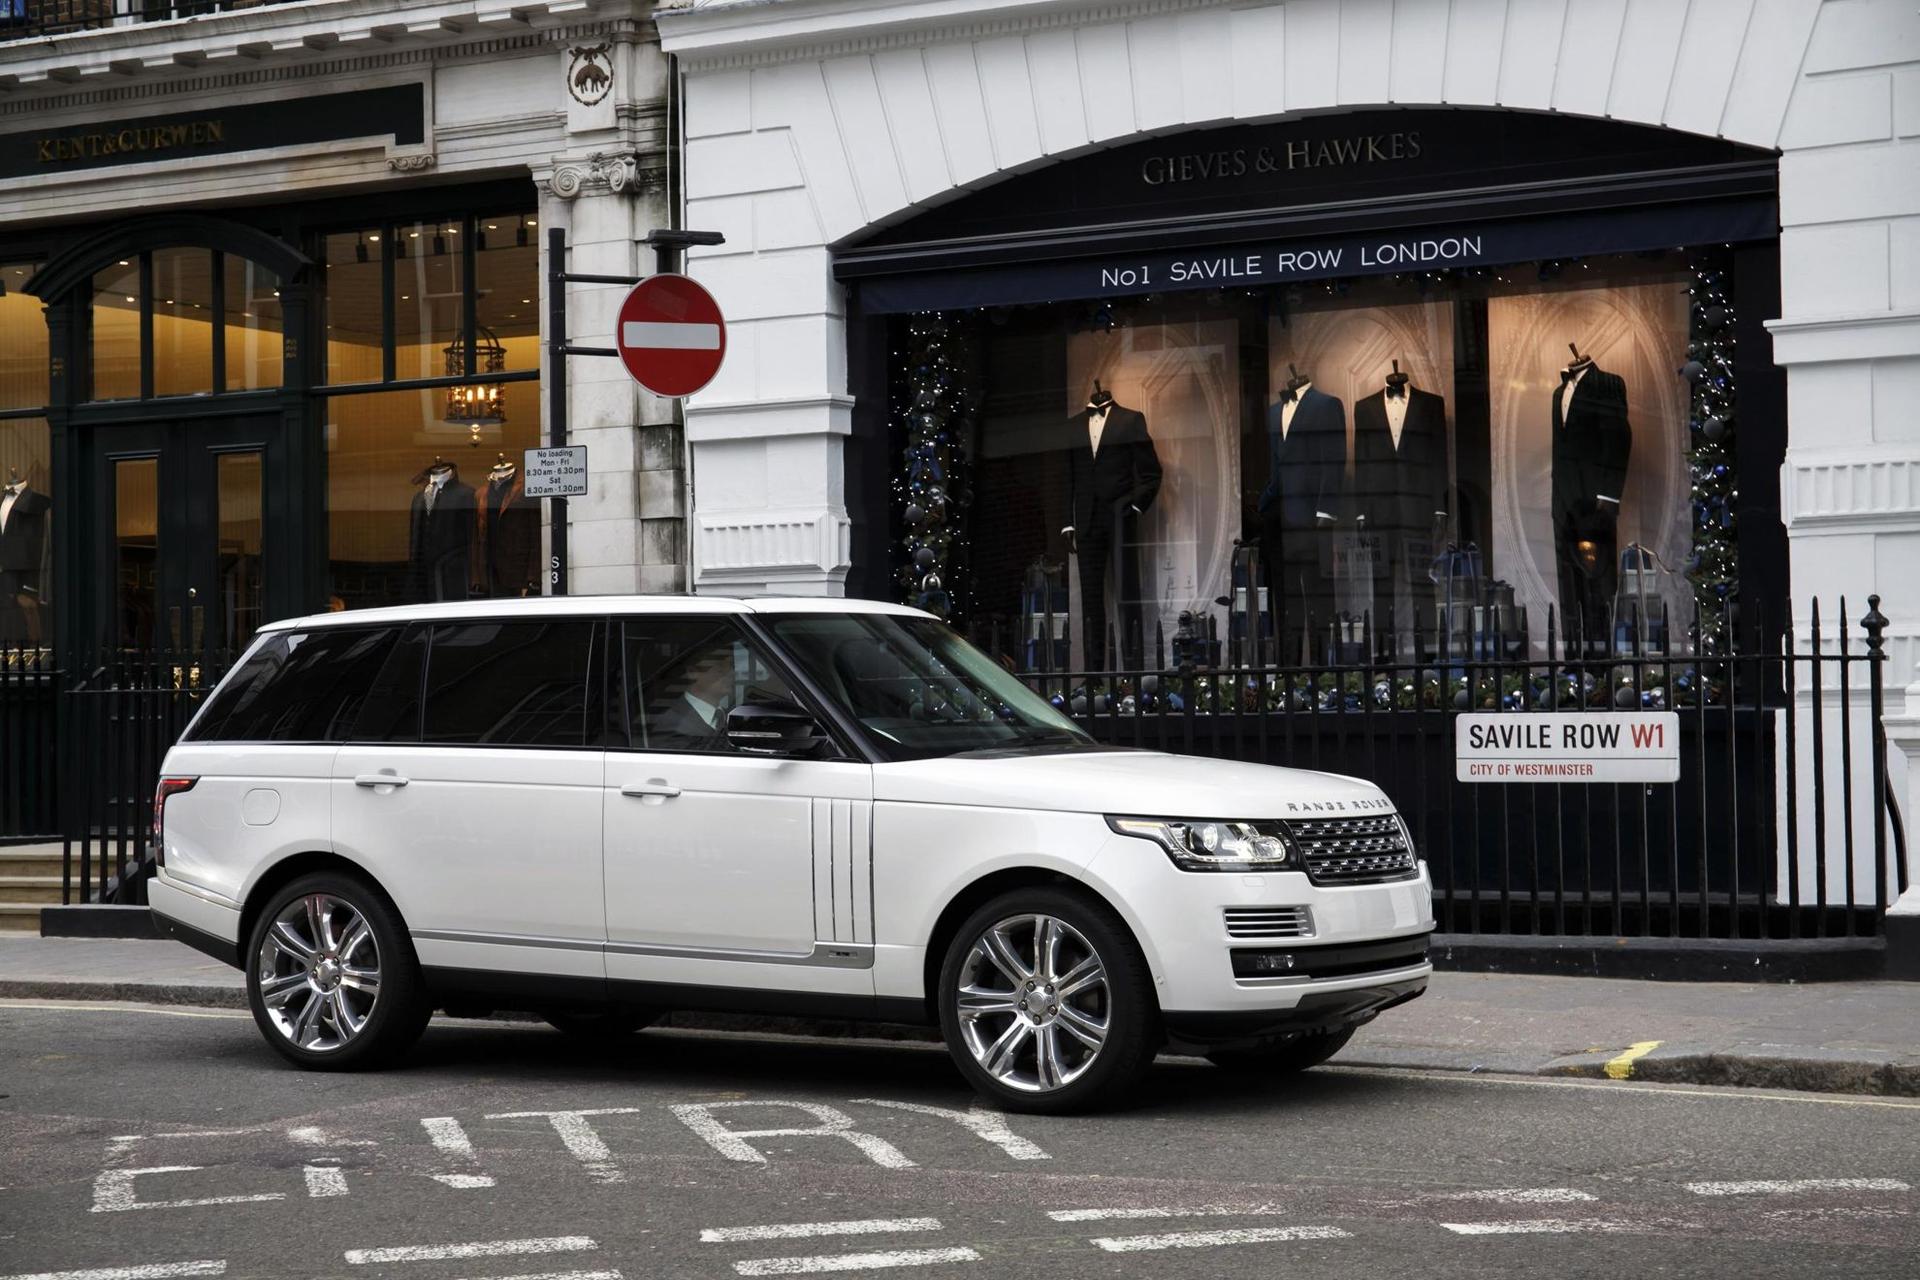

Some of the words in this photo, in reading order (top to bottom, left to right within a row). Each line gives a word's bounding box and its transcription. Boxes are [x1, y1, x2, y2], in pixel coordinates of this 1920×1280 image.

[1142, 148, 1247, 185] GIEVES
[1255, 148, 1279, 172] &
[1287, 131, 1422, 170] HAWKES
[1101, 265, 1151, 287] No1
[1169, 255, 1262, 282] SAVILE
[1278, 248, 1343, 273] ROW
[1361, 235, 1482, 266] LONDON
[548, 450, 573, 458] loading
[540, 459, 555, 467] Mon
[560, 458, 570, 466] Fri
[551, 556, 560, 569] S
[551, 571, 559, 584] 3
[1469, 723, 1551, 749] SAVILE
[1563, 723, 1621, 749] ROW
[1631, 723, 1664, 749] W1
[1470, 764, 1494, 776] CITY
[1497, 764, 1511, 776] OF
[1514, 764, 1594, 776] WESTMINSTER
[1287, 801, 1346, 812] RANGE
[1352, 798, 1390, 811] ROVER
